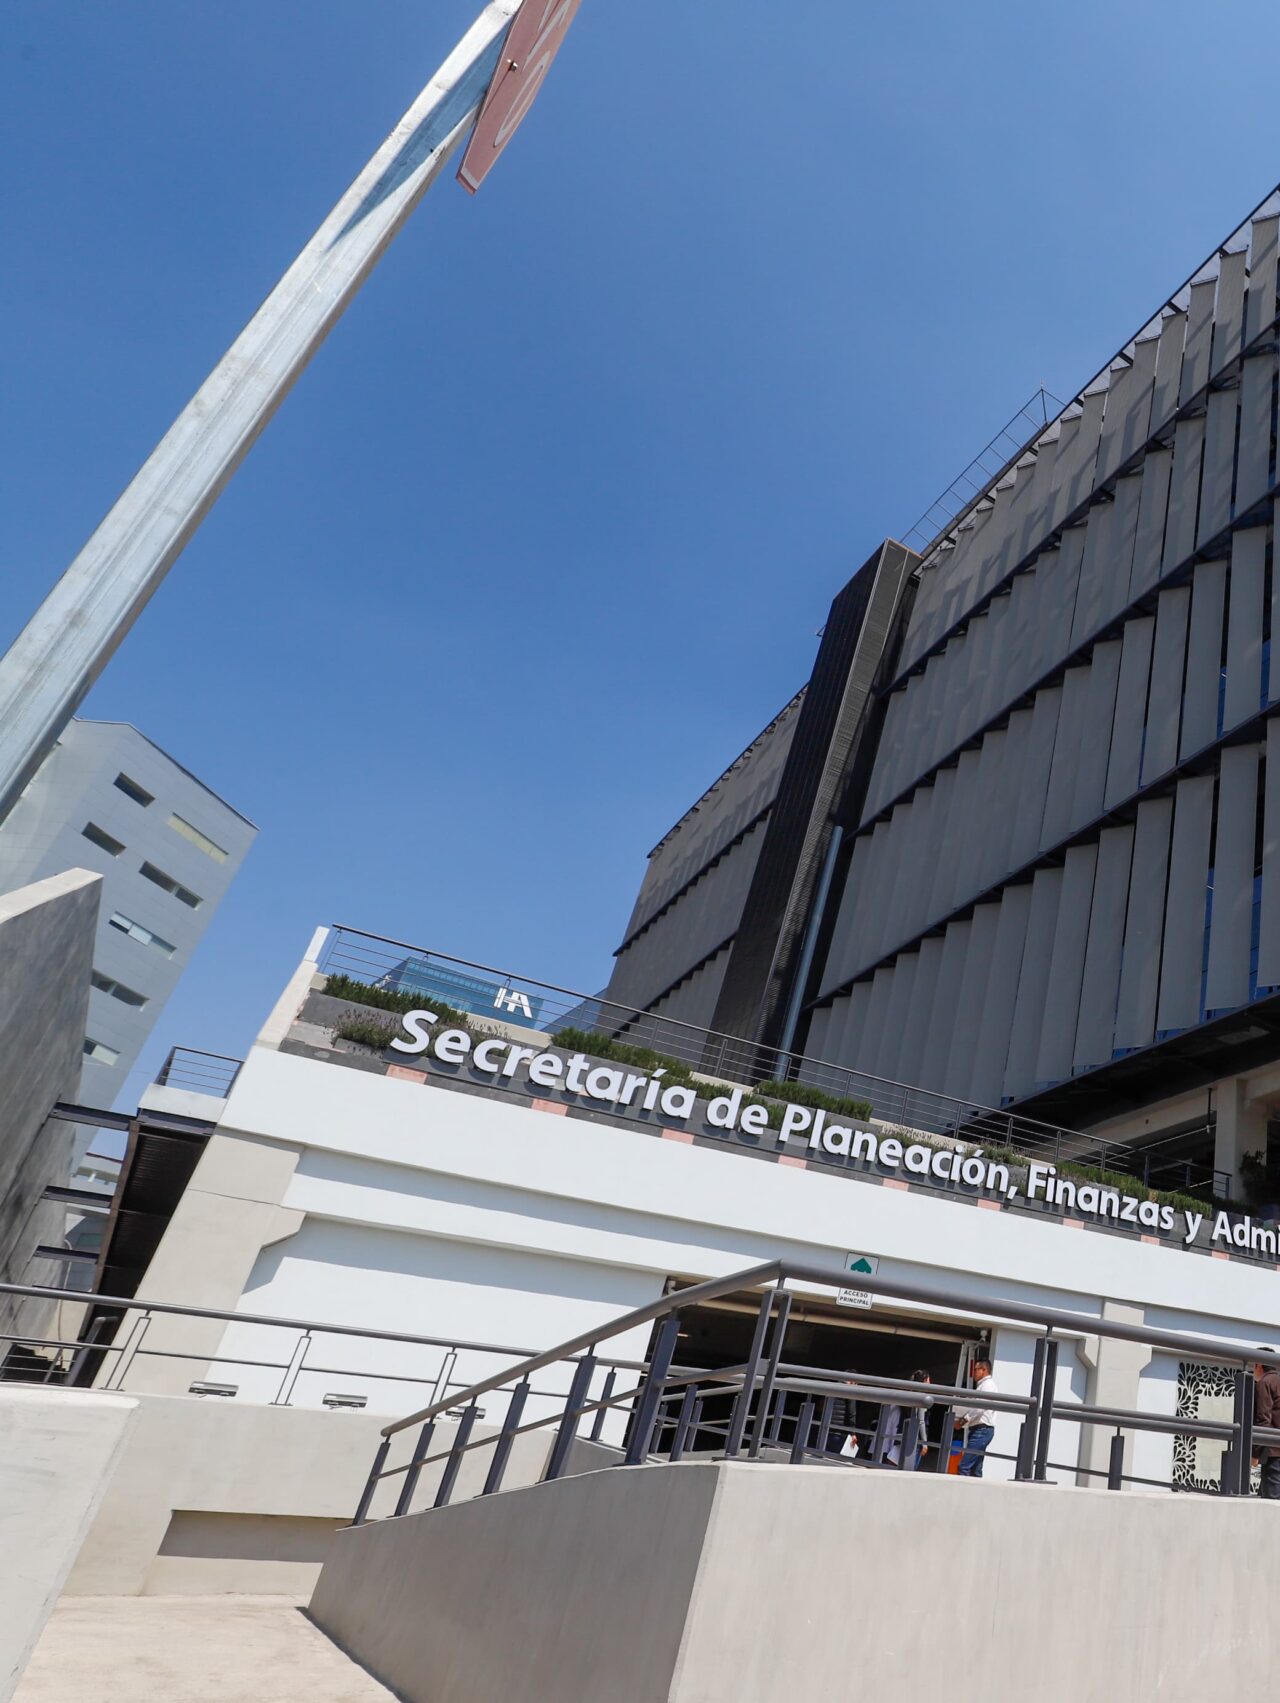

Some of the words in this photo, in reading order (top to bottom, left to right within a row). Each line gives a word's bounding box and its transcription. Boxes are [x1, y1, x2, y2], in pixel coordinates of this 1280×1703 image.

[390, 1010, 697, 1119] Secretaría
[706, 1089, 769, 1136] de
[778, 1104, 1018, 1200] Planeación,
[1027, 1166, 1175, 1231] Finanzas
[1184, 1211, 1202, 1243] y
[844, 1290, 868, 1298] ACCESO
[839, 1296, 869, 1305] PRINCIPAL
